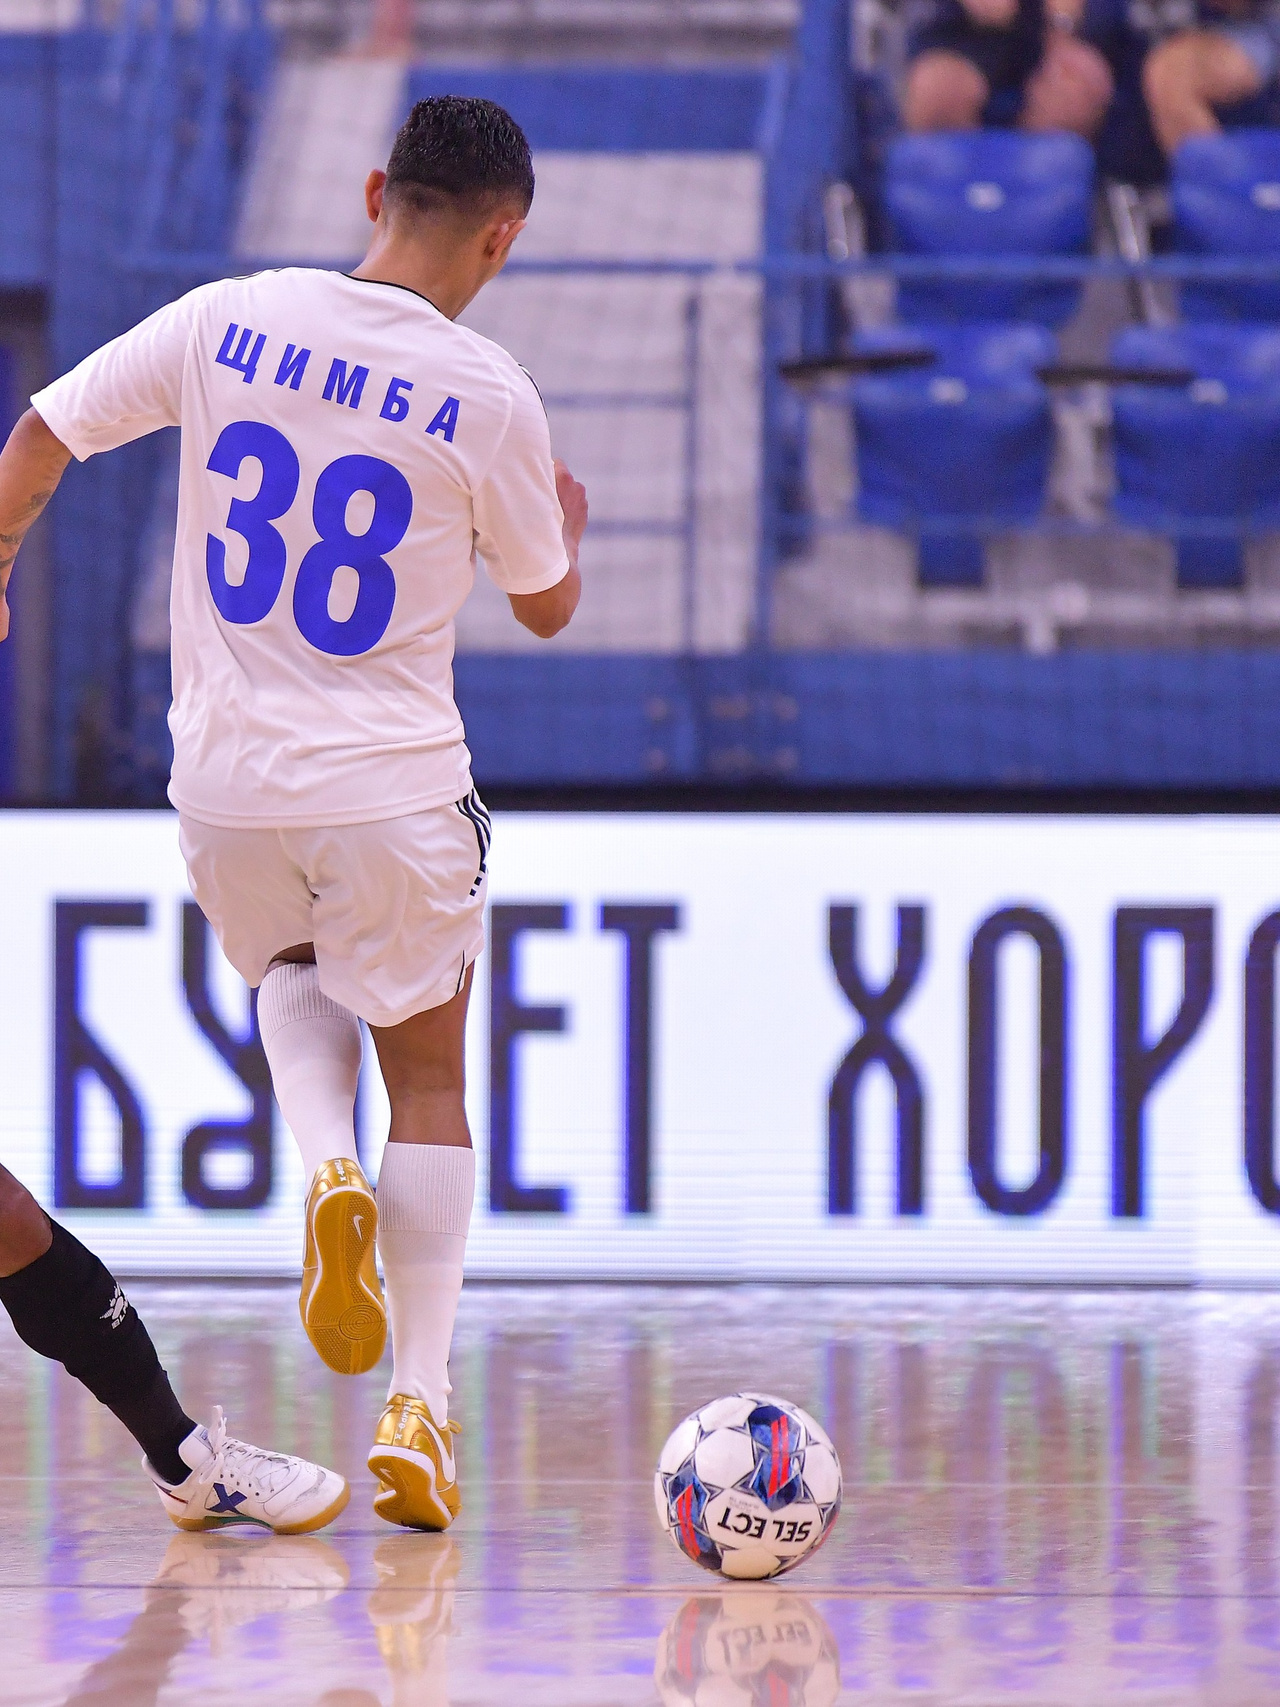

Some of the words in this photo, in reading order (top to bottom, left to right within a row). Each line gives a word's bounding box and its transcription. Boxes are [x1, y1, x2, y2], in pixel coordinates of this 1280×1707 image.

[215, 322, 461, 443] ЩИМБА
[205, 420, 414, 657] 38
[55, 900, 682, 1215] БУЕТ
[717, 1507, 813, 1543] SELECT
